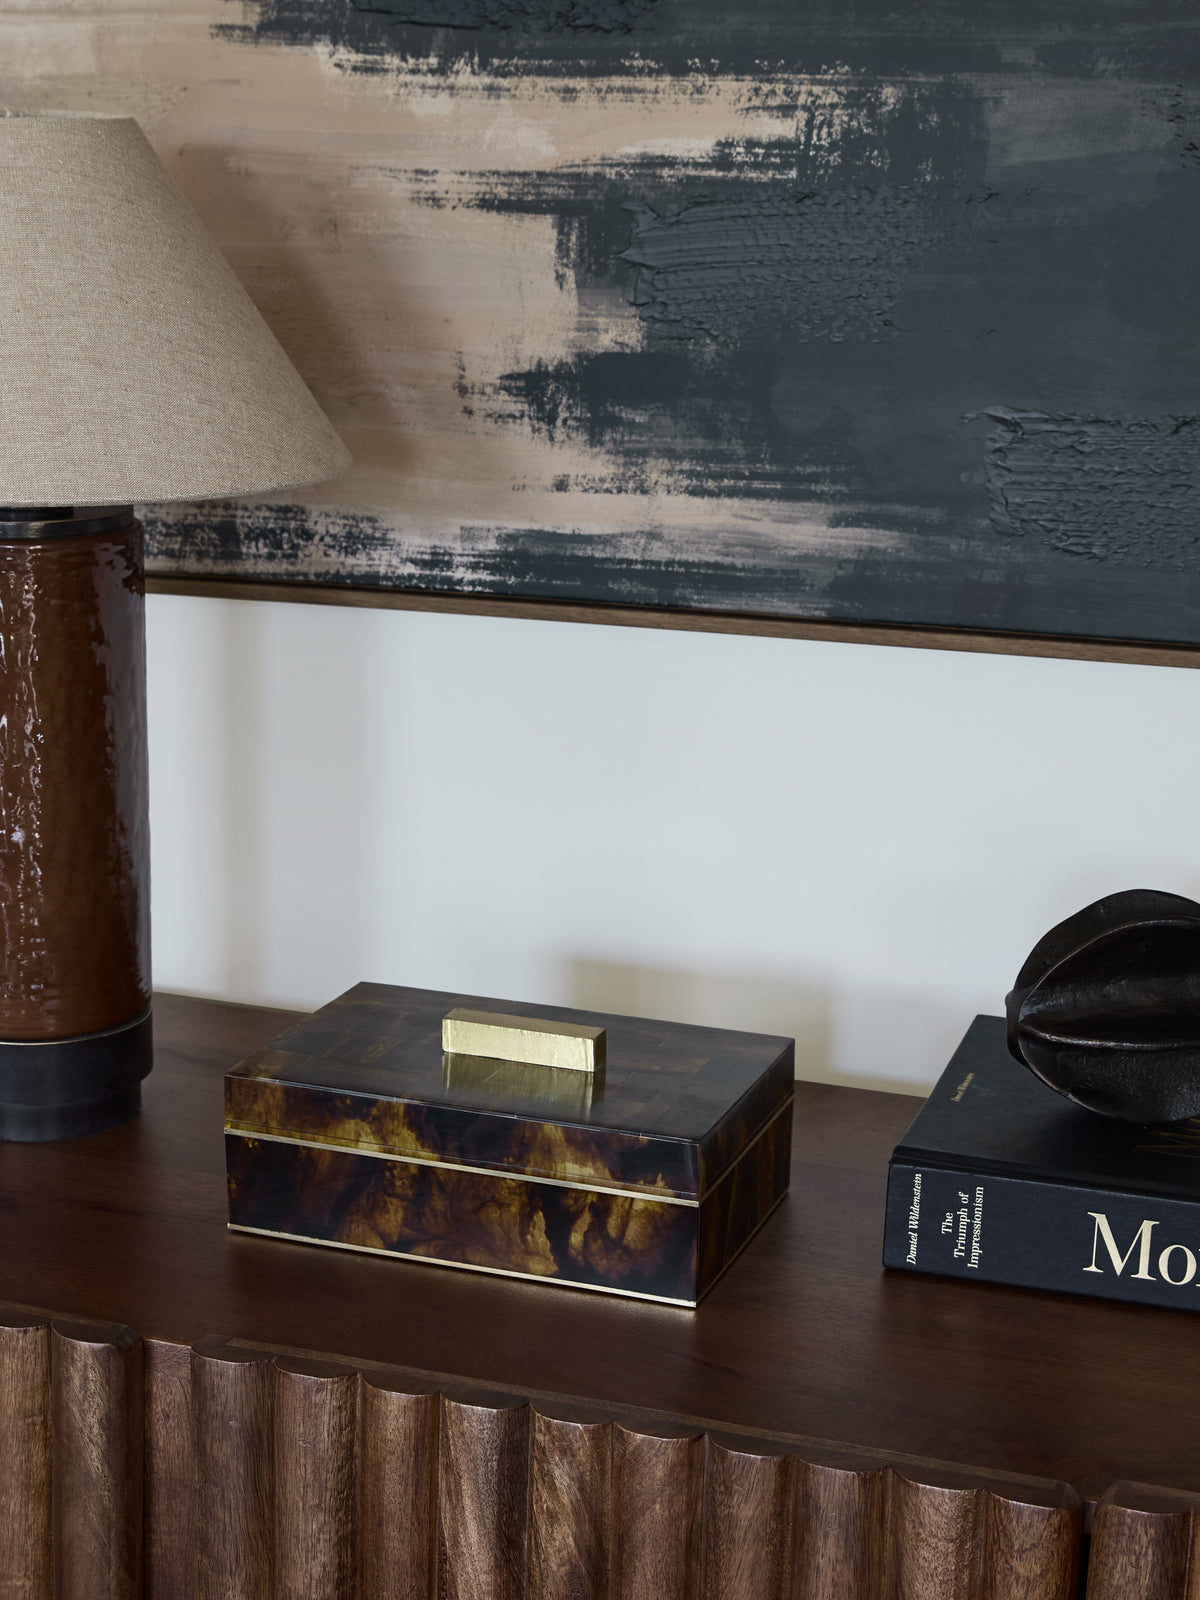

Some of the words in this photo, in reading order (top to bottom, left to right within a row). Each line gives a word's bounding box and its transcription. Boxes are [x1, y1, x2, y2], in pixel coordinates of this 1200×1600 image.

[908, 1173, 922, 1229] Wildenstein
[958, 1191, 969, 1204] of
[906, 1231, 918, 1265] Daniel
[941, 1212, 954, 1235] The
[953, 1208, 970, 1258] Triumph
[967, 1186, 984, 1269] Impressionism
[1082, 1211, 1200, 1287] Mo
